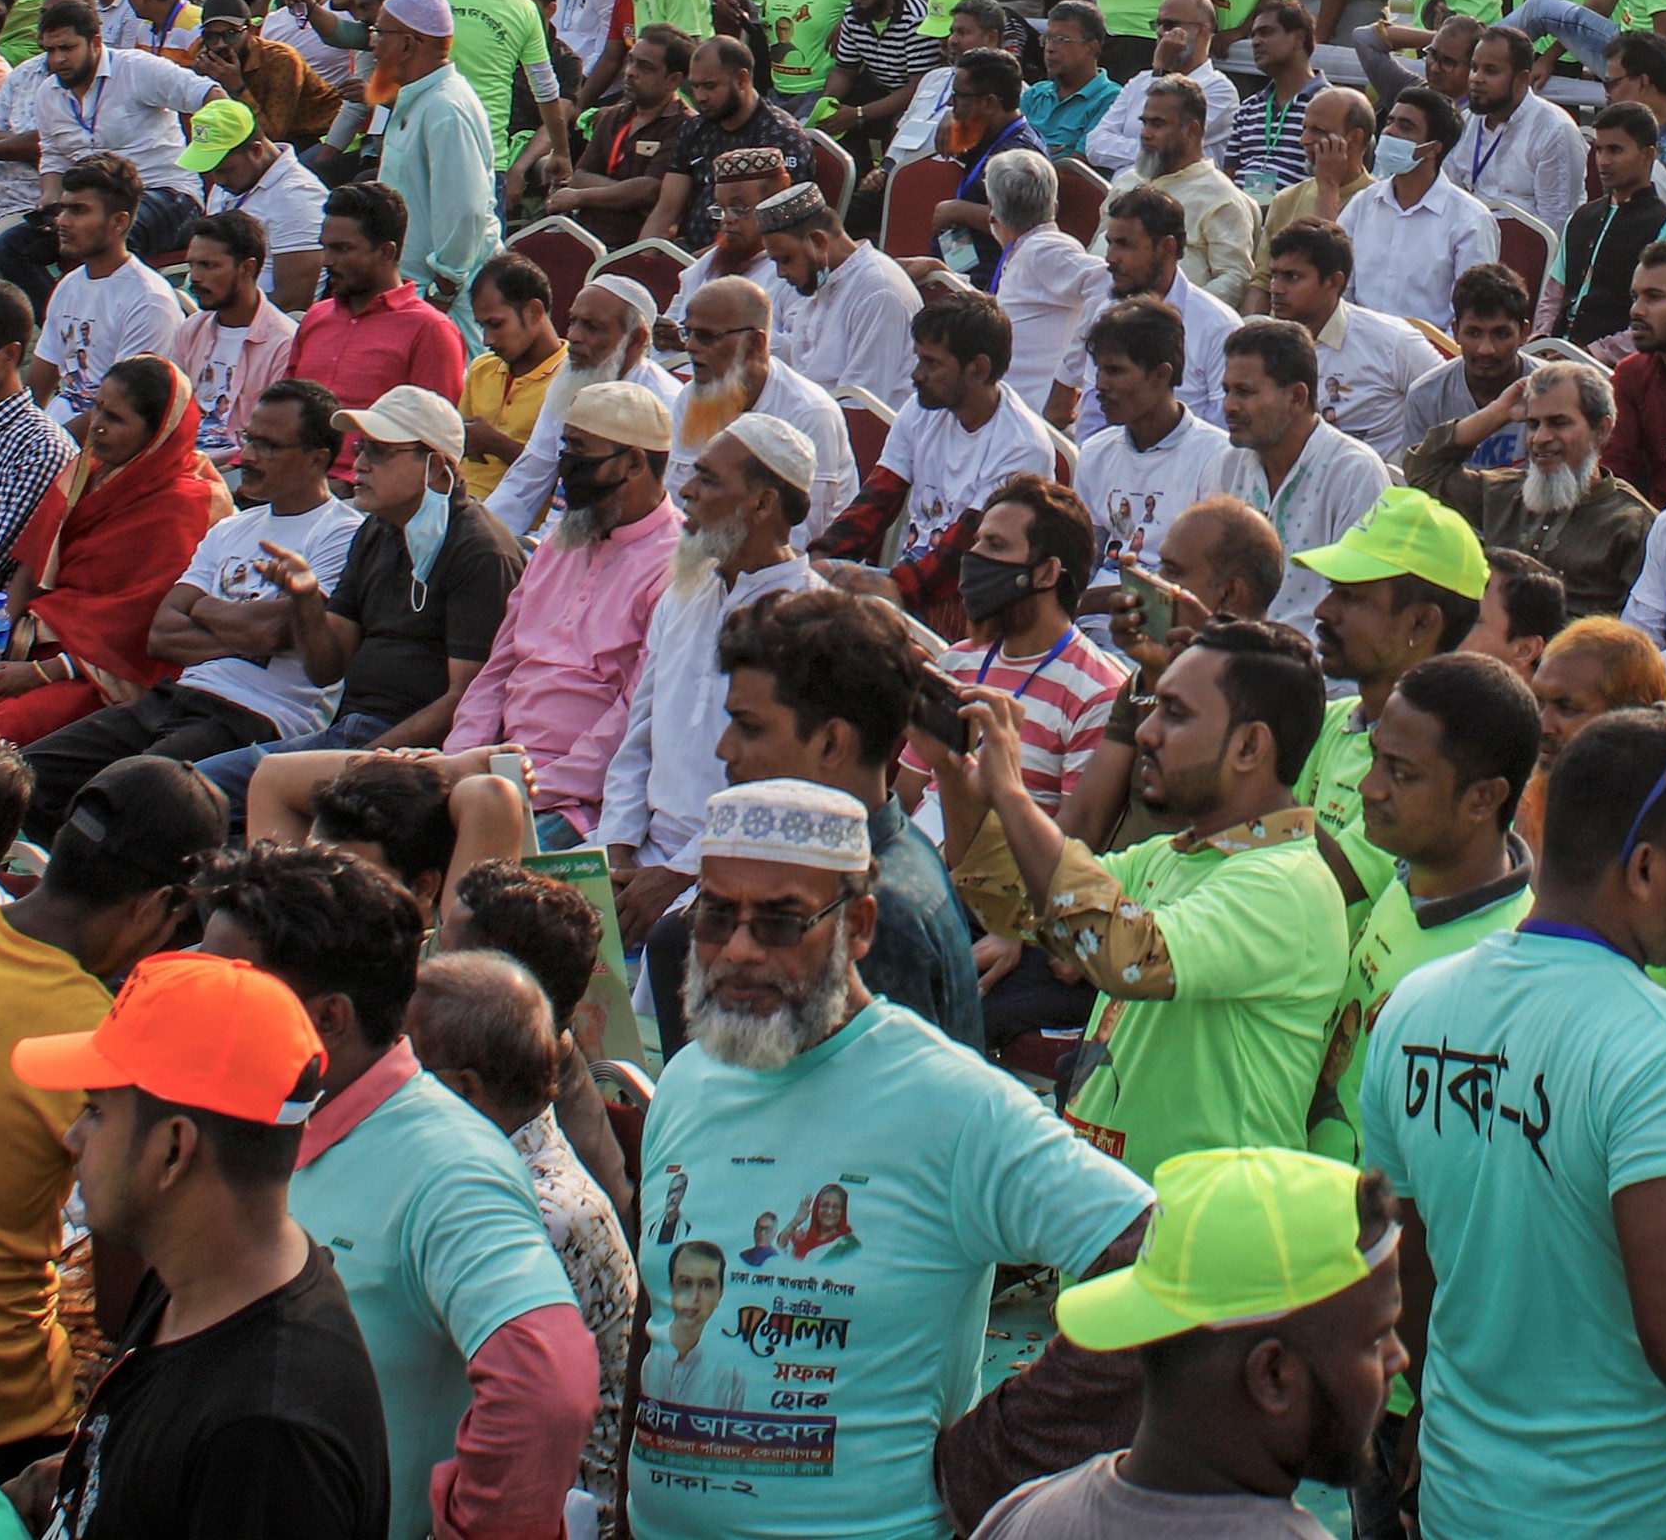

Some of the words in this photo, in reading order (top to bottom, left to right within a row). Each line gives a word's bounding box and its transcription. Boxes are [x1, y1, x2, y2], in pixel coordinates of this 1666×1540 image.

[1402, 1035, 1553, 1174] ঢাকা-২
[1096, 1135, 1114, 1154] লীগ
[730, 1271, 749, 1283] ঢাকা
[751, 1272, 775, 1284] জেলা
[777, 1274, 819, 1293] আওয়ামী
[822, 1277, 856, 1297] লীগের
[722, 1306, 849, 1356] সম্মেলন
[772, 1361, 837, 1384] সফল
[770, 1389, 830, 1411] হোক
[689, 1415, 833, 1443] আহমেদ
[649, 1468, 759, 1499] ঢাকা-২
